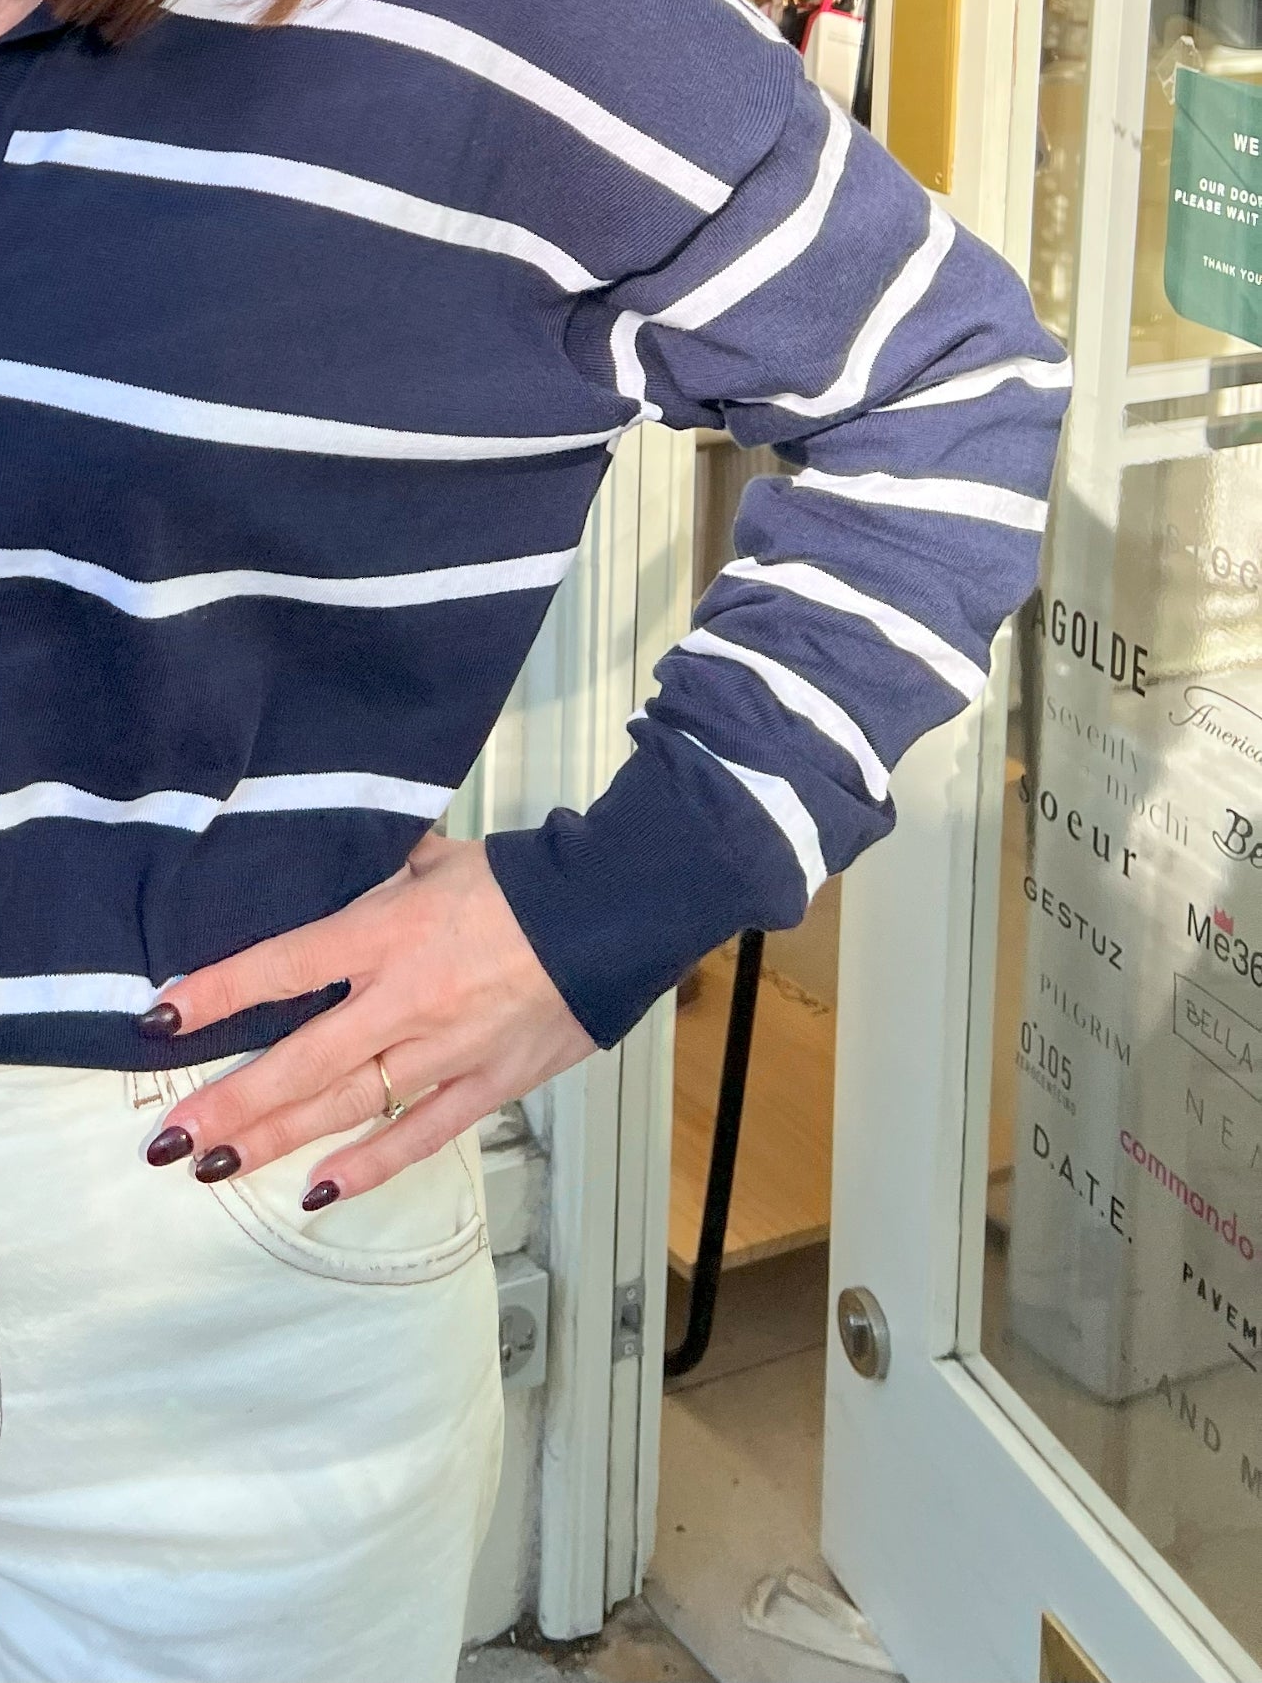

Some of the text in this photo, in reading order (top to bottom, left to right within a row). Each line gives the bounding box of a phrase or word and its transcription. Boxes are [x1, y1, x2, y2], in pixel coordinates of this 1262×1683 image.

[1198, 176, 1226, 198] OUR
[1232, 131, 1260, 157] WE
[1173, 188, 1260, 227] PLEASE WAIT
[1201, 254, 1237, 278] THANK
[1032, 588, 1149, 697] AGOLDE
[1019, 774, 1137, 879] soeur
[1024, 875, 1124, 971] GESTUZ
[1038, 972, 1132, 1066] PILGRIM
[1185, 997, 1254, 1074] BELLA
[1033, 1122, 1133, 1244] D.A.T.E.
[1119, 1128, 1255, 1261] commando
[1156, 1373, 1222, 1453] AND
